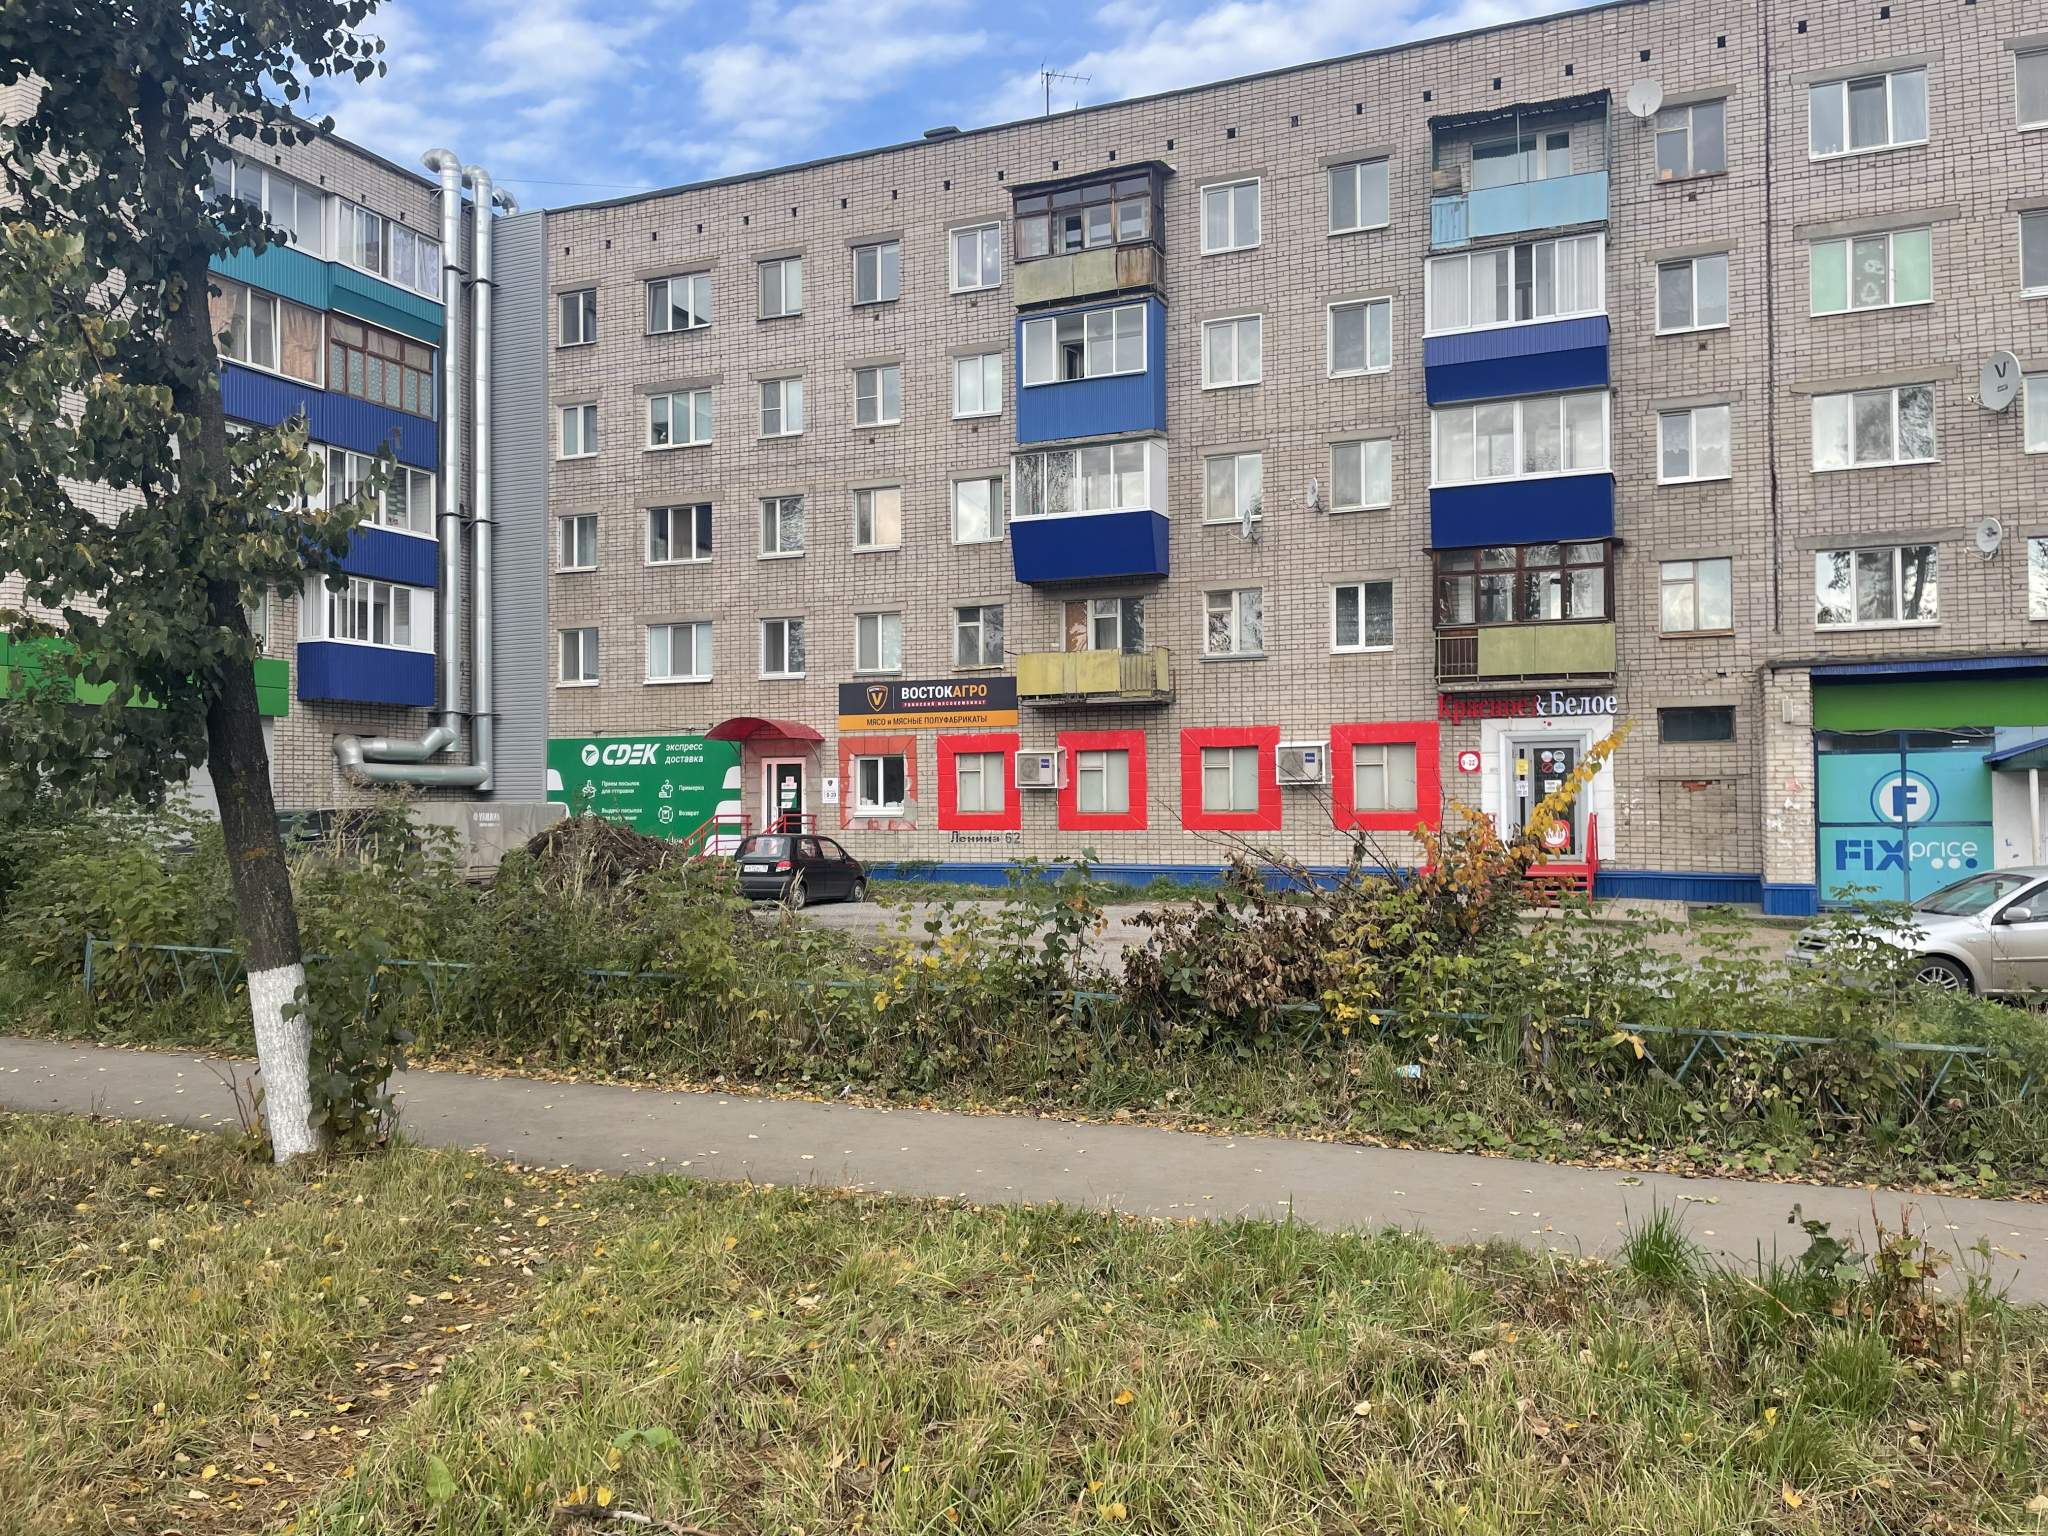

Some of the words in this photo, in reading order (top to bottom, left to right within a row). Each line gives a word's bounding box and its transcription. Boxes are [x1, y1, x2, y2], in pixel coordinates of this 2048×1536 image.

[901, 684, 988, 700] ВОСТОКАГРО
[866, 718, 886, 726] МЯСО
[893, 717, 923, 726] МЯСНЫЕ
[924, 715, 988, 725] ПОЛУФАБРИКАТЫ
[665, 743, 703, 752] экспресс
[665, 755, 704, 765] доставка
[1892, 785, 1918, 817] F
[950, 830, 1000, 843] Ленина
[1005, 832, 1021, 844] 62
[1910, 841, 1978, 861] price
